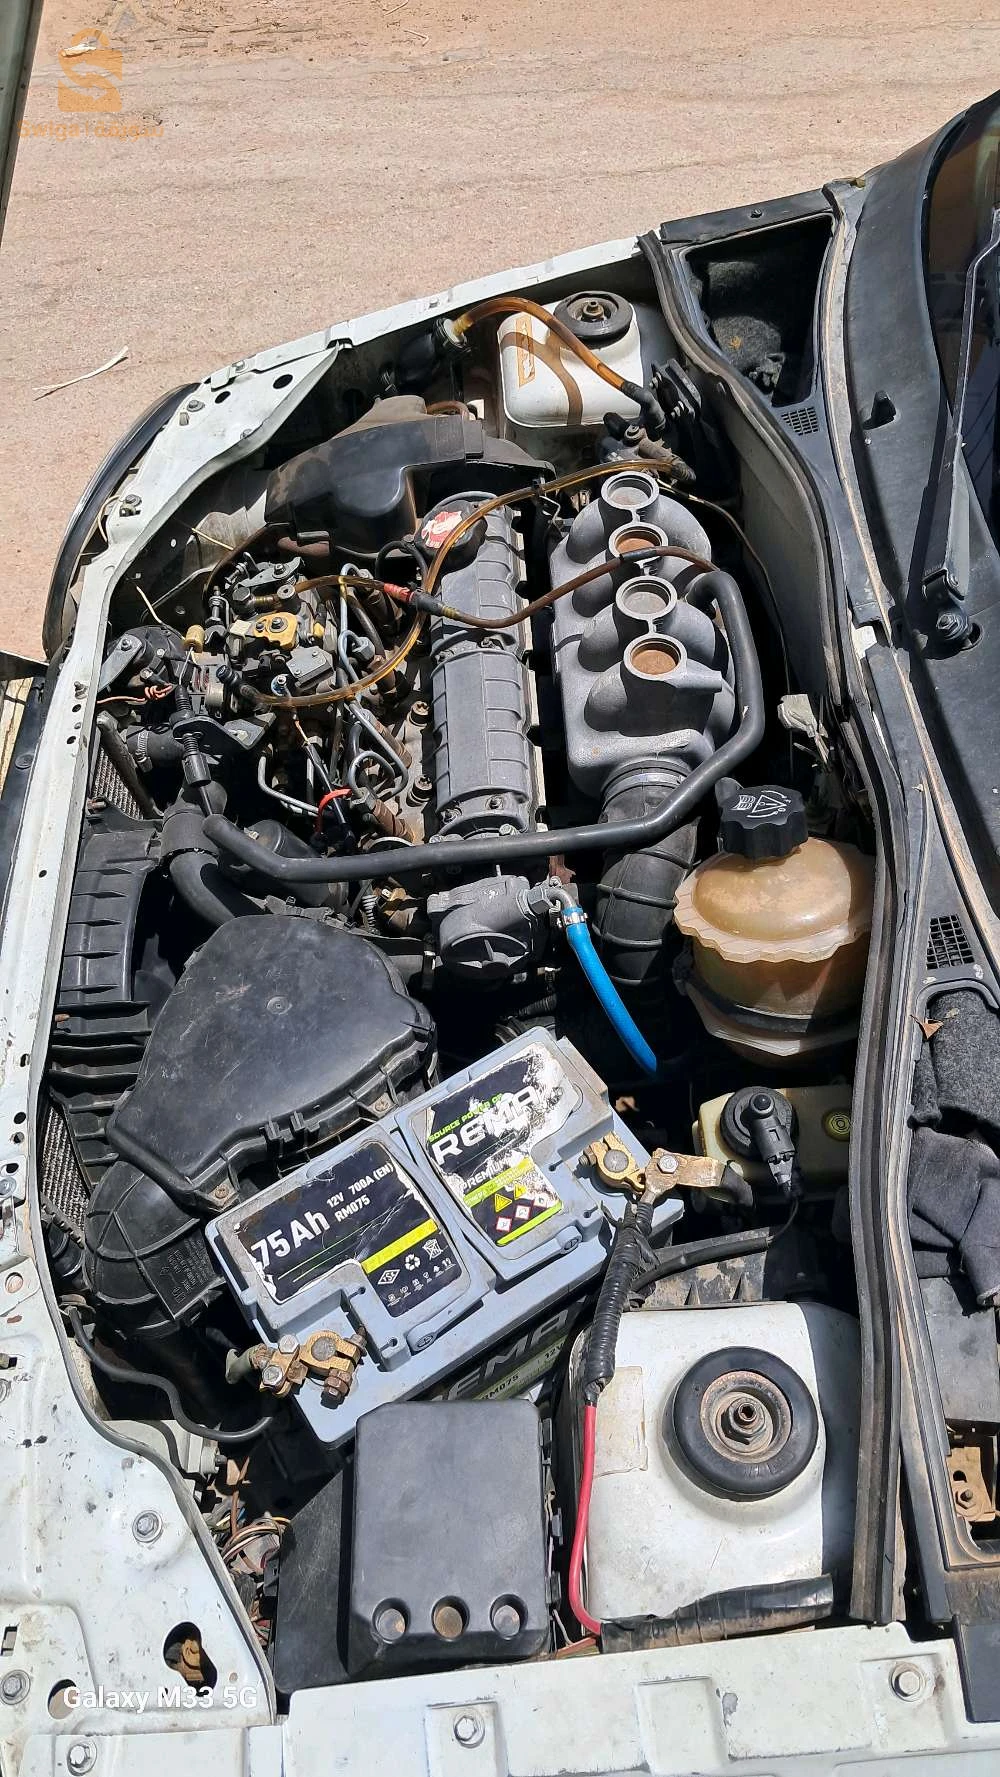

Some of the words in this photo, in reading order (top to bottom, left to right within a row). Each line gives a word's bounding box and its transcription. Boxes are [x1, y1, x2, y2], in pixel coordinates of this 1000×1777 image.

[428, 1119, 461, 1143] SOURCE
[431, 1085, 540, 1166] REMA
[326, 1191, 345, 1209] 12V
[348, 1175, 375, 1195] 700A
[373, 1162, 394, 1181] (EN)
[334, 1194, 371, 1222] RM075
[432, 1309, 569, 1400] EMA
